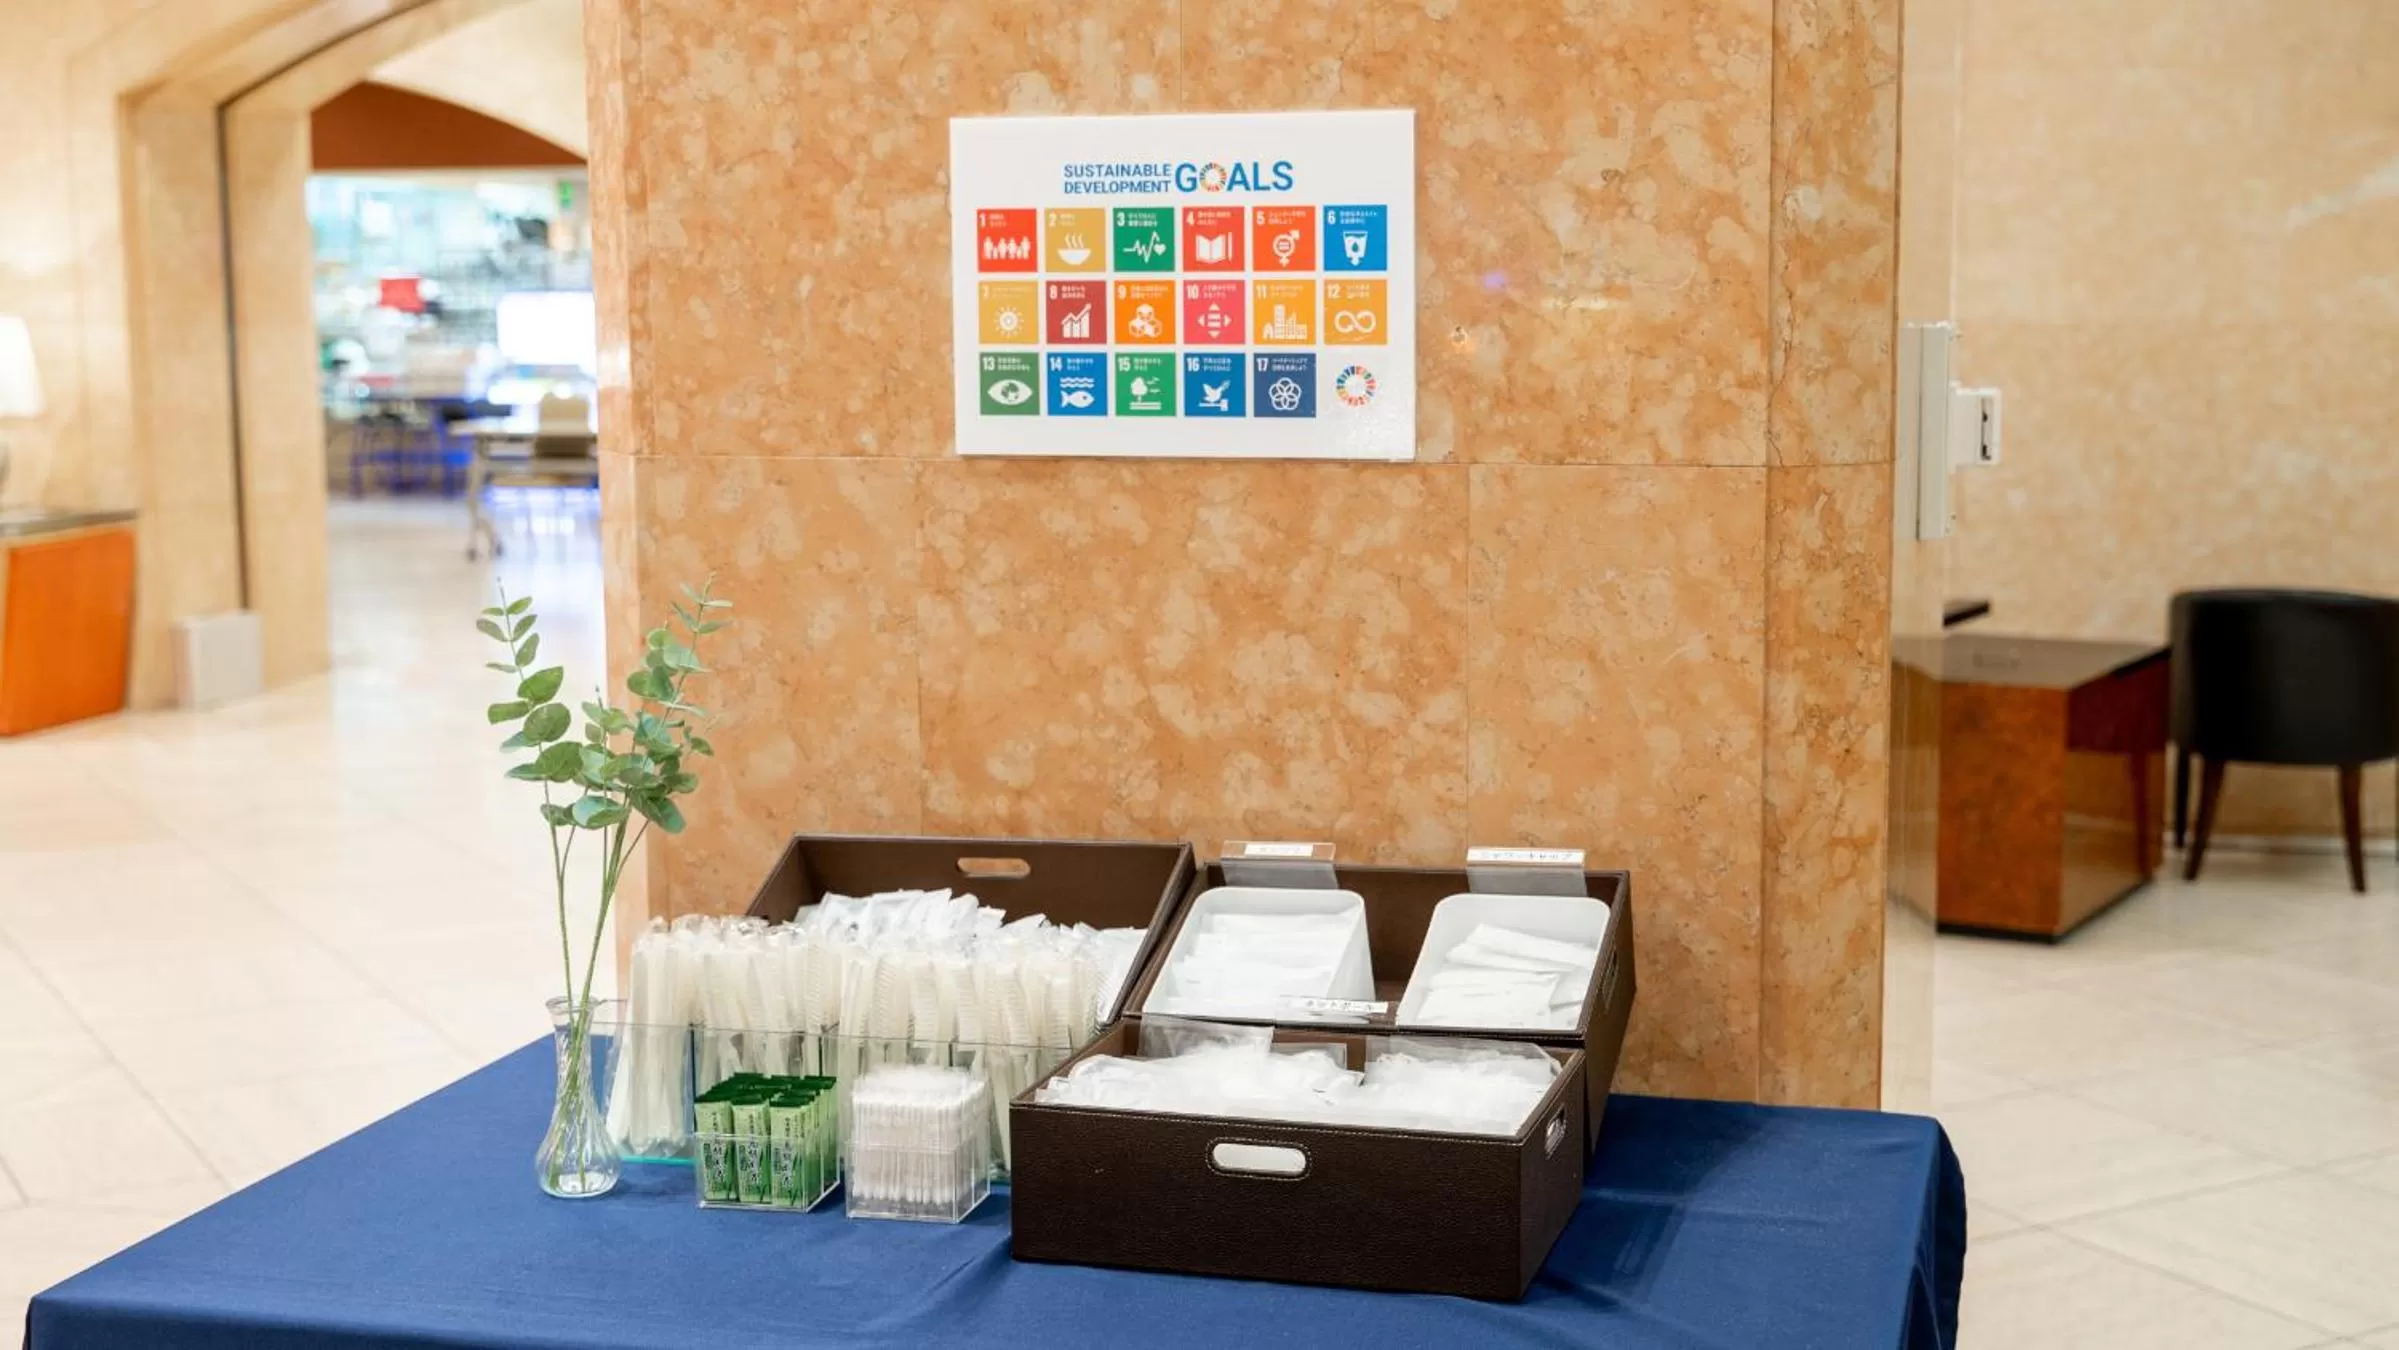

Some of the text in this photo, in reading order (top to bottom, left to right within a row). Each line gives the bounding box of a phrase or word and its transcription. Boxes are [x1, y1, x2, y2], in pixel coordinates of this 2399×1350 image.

[1064, 163, 1171, 177] SUSTAINABLE
[1175, 161, 1293, 192] GOALS
[1064, 180, 1171, 194] DEVELOPMENT
[980, 213, 986, 228] 1
[1049, 212, 1057, 227] 2
[1117, 212, 1125, 227] 3
[1186, 211, 1194, 226] 4
[1256, 210, 1265, 225] 5
[1328, 210, 1336, 225] 6
[982, 285, 989, 299] 7
[1050, 285, 1057, 299] 8
[1118, 285, 1126, 299] 9
[1187, 285, 1199, 299] 10
[1256, 284, 1267, 300] 11
[1328, 284, 1340, 298] 12
[983, 357, 995, 371] 13
[1050, 357, 1062, 371] 14
[1118, 357, 1131, 371] 15
[1187, 357, 1200, 371] 16
[1256, 358, 1269, 371] 17
